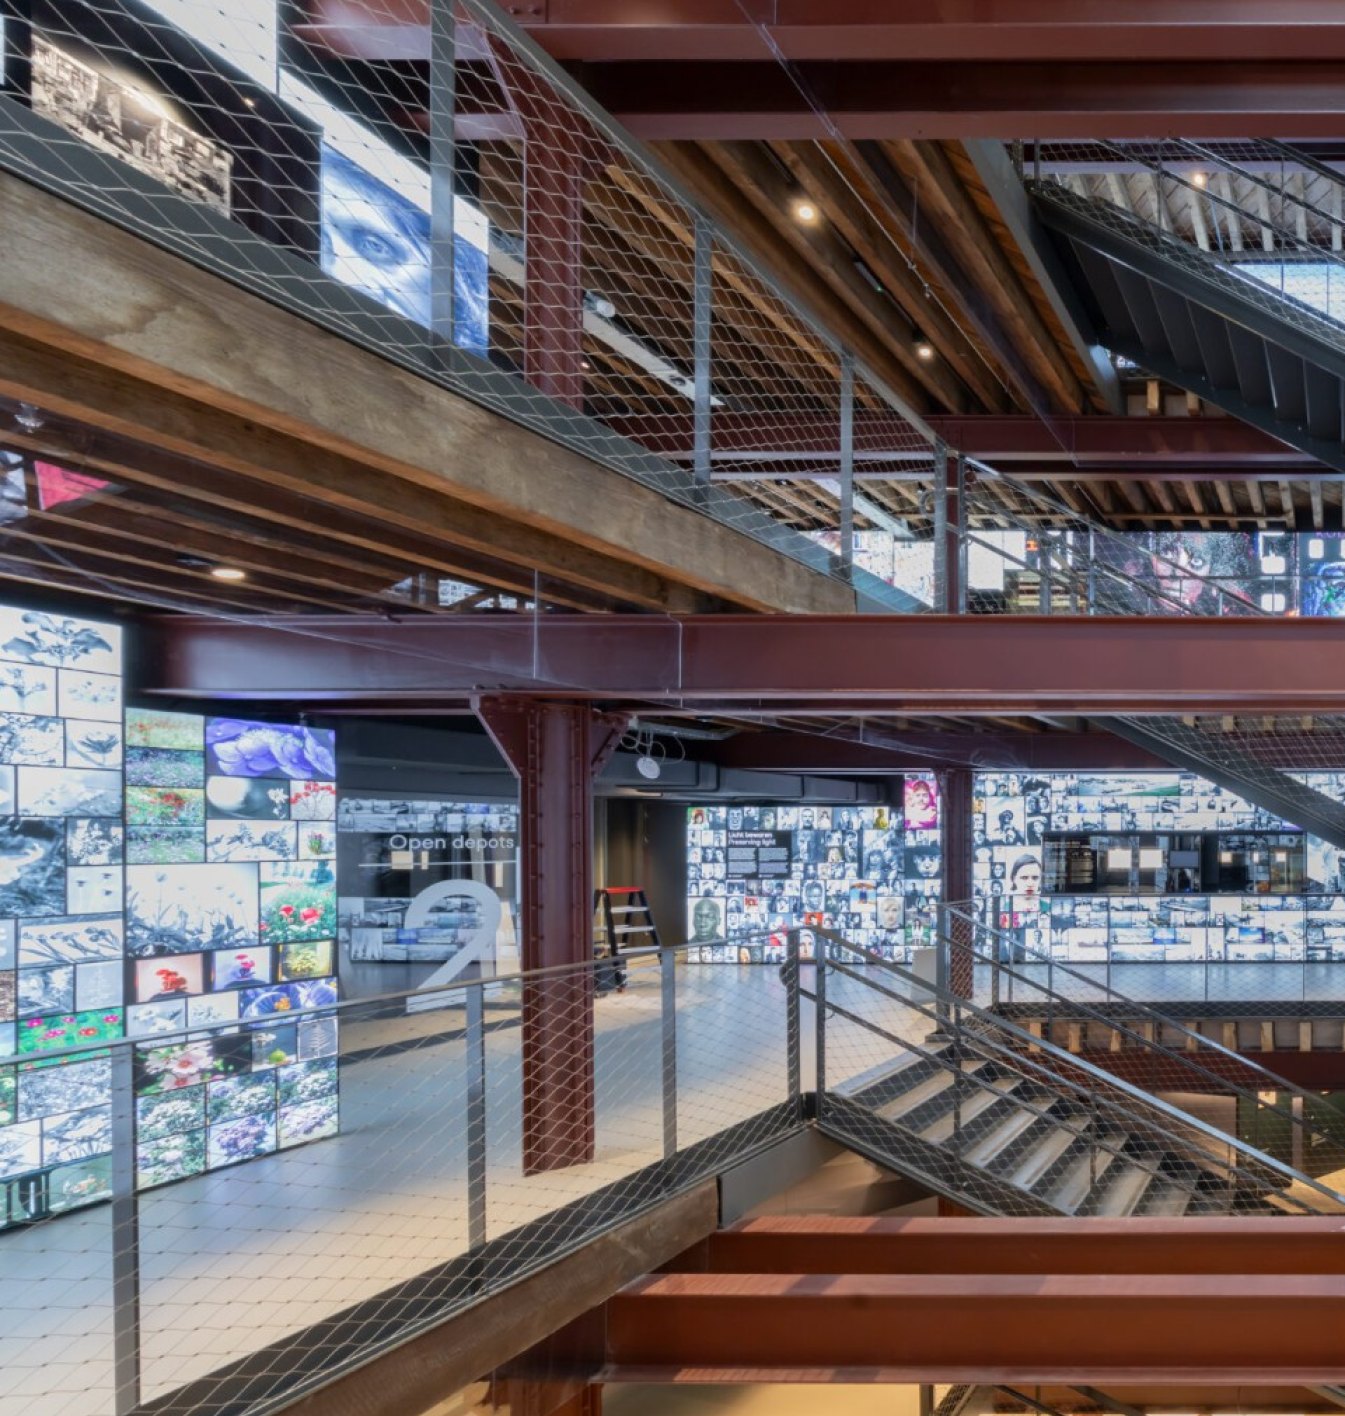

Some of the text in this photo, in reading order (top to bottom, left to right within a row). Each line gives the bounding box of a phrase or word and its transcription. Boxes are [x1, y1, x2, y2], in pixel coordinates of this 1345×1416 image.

[390, 834, 515, 853] Open depots
[404, 879, 503, 1013] 2
